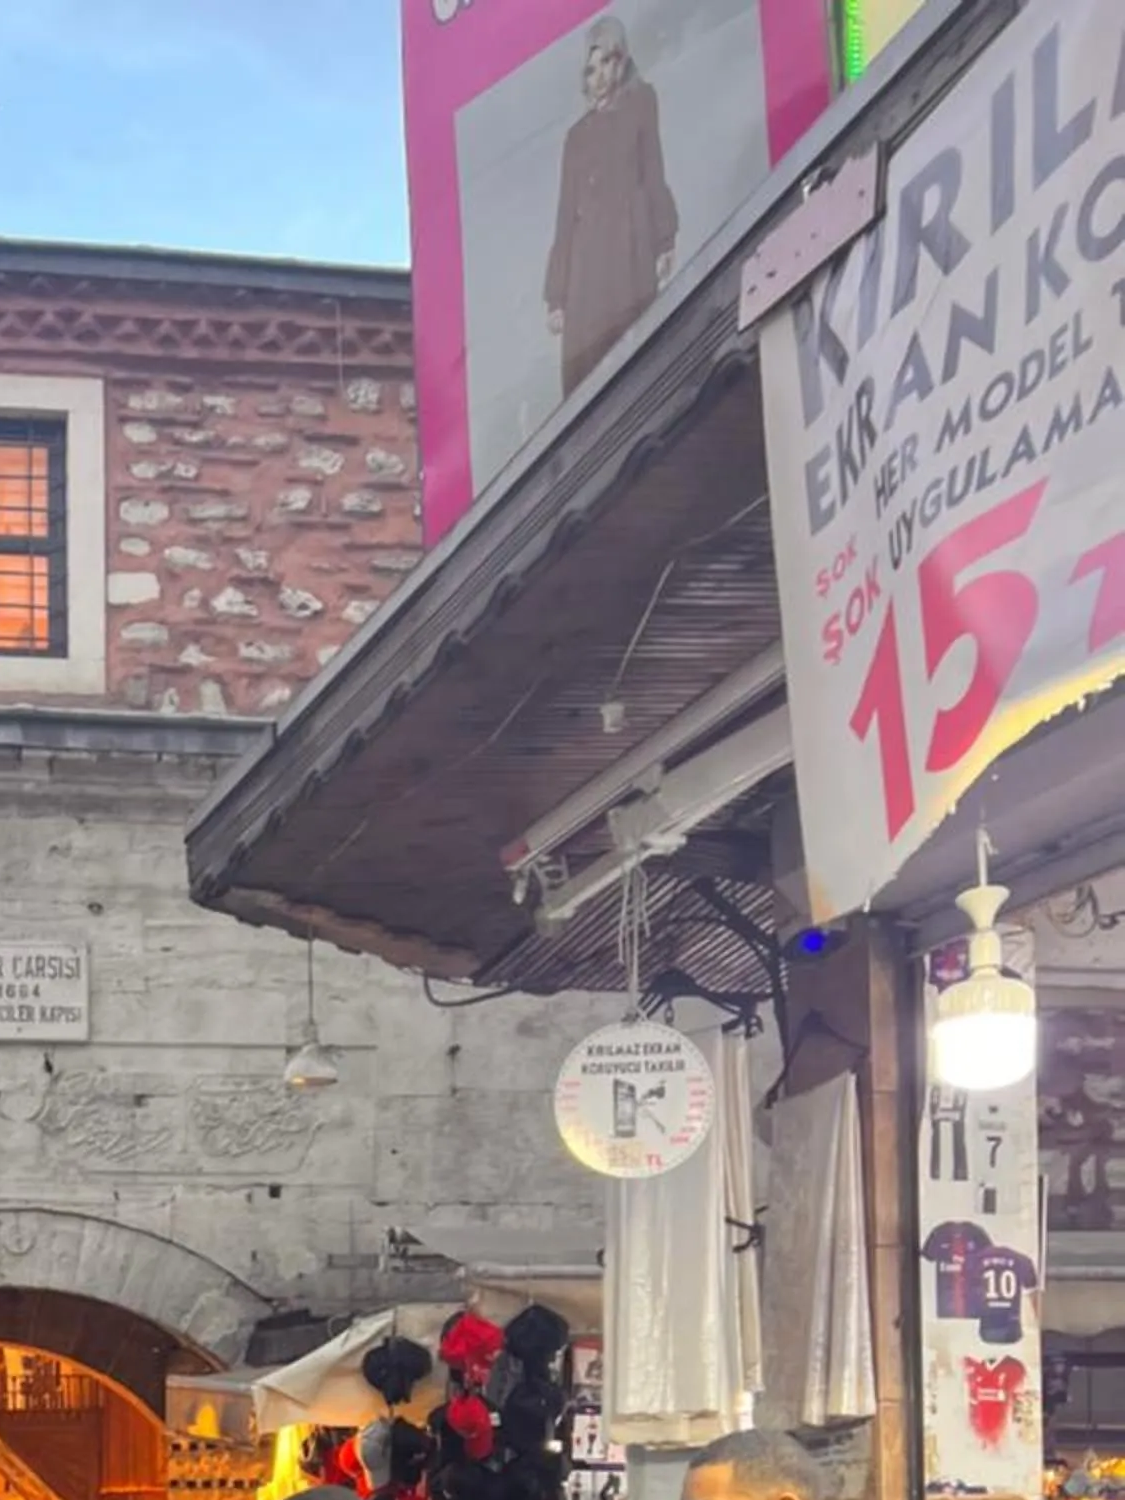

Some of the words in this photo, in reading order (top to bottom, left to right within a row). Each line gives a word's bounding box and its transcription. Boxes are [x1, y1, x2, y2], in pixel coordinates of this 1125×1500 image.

[792, 20, 1125, 430] KIRIL
[804, 264, 1000, 537] EKRAN
[873, 432, 919, 520] HER
[935, 308, 1093, 454] MODEL
[888, 366, 1124, 571] UYGULAMA
[848, 474, 1040, 844] 15
[986, 1135, 1003, 1169] 7
[983, 1269, 1017, 1299] 10
